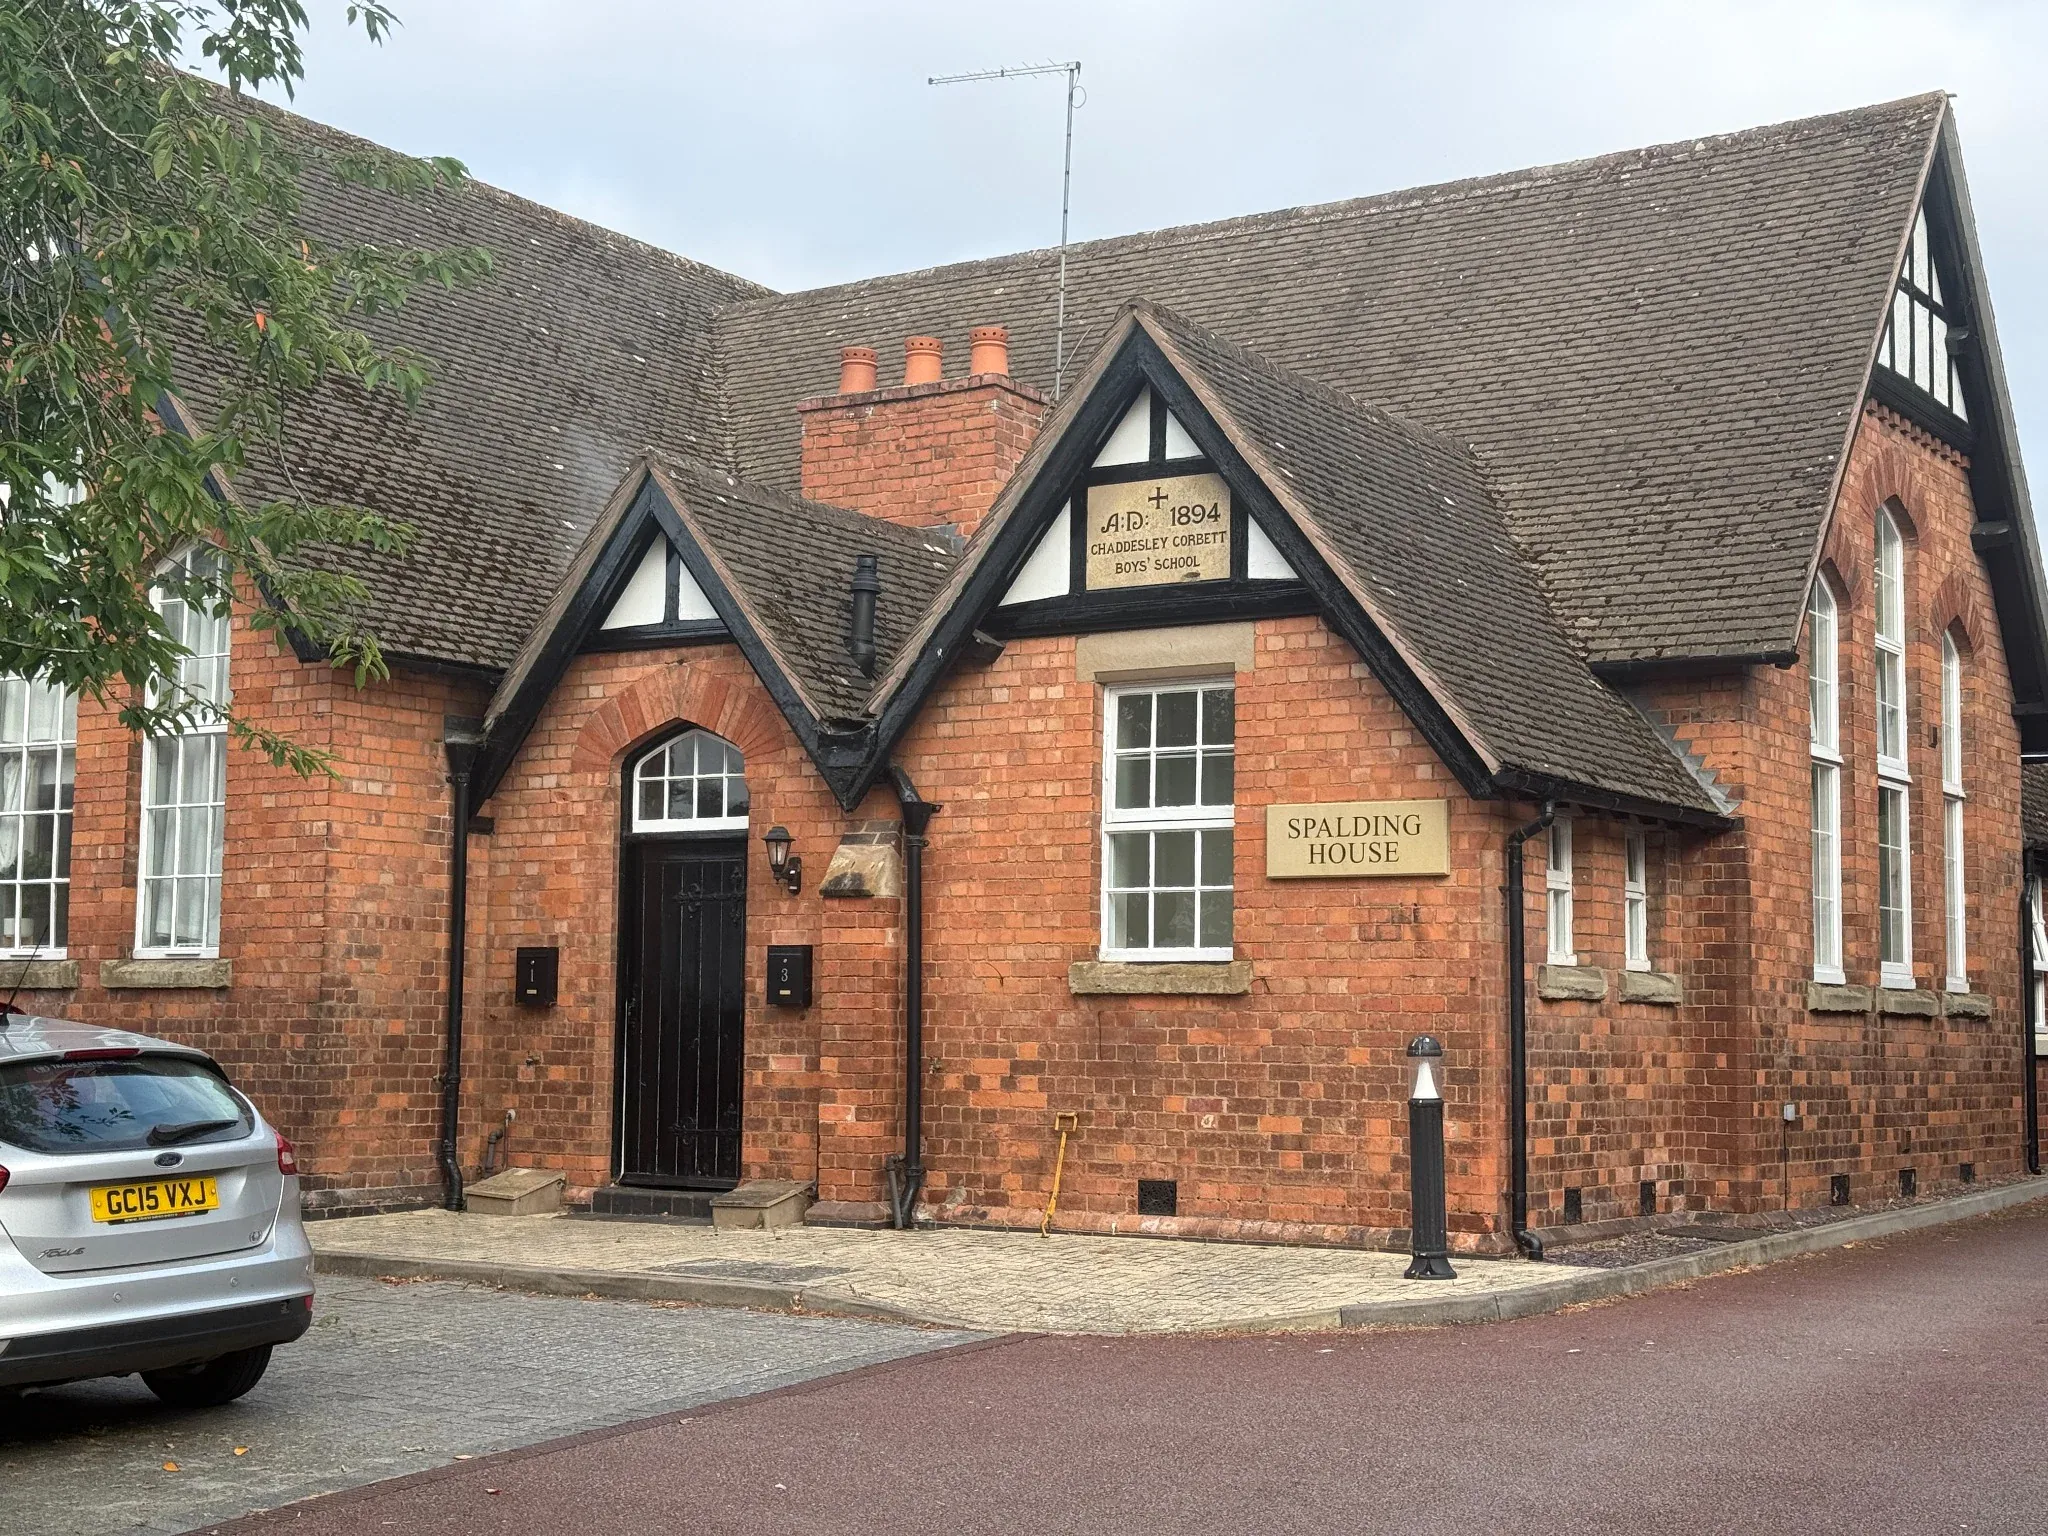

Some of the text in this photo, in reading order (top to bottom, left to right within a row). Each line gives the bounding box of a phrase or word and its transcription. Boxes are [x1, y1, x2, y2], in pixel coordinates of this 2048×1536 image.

[1170, 503, 1221, 526] 1894
[1091, 531, 1227, 555] CHADDESLEY CORBETT
[1115, 556, 1200, 574] BOYS' SCHOOL
[1288, 814, 1422, 839] SPALDING
[1308, 841, 1400, 865] HOUSE
[781, 967, 788, 982] 3
[106, 1181, 206, 1215] GC15 VXJ
